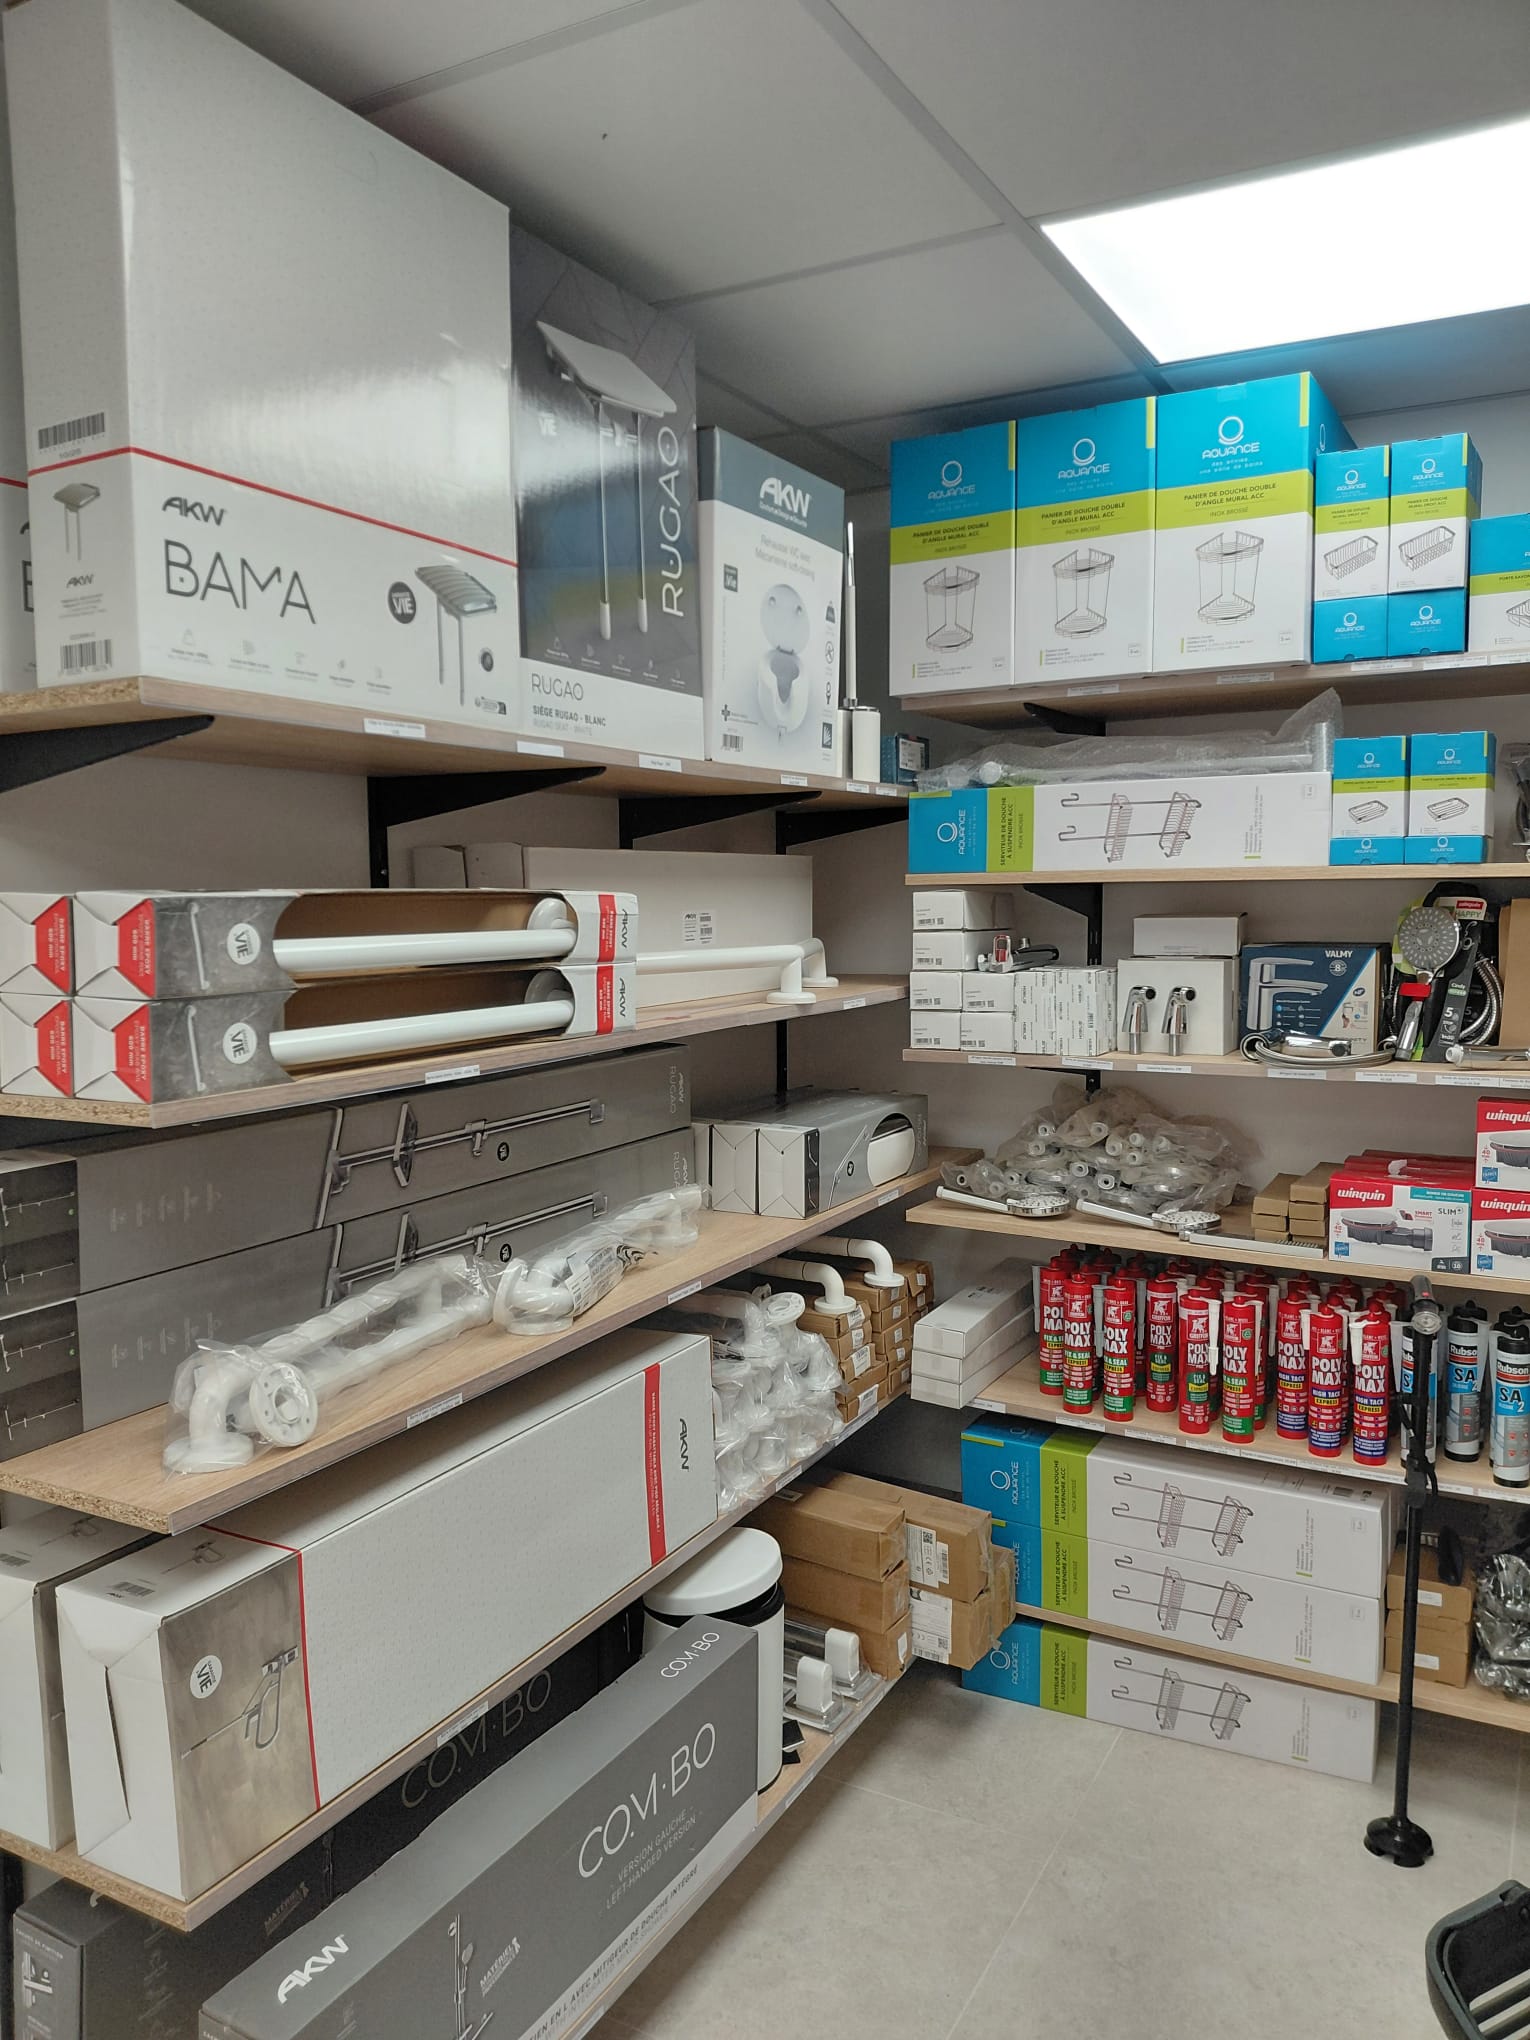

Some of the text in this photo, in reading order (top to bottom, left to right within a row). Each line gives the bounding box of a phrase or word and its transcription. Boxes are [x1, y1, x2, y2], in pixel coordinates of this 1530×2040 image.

[1202, 442, 1260, 459] AQUANCE
[1058, 463, 1111, 479] AQUANCE
[1412, 472, 1444, 481] AQUANCE
[927, 484, 976, 500] AQUANCE
[1184, 483, 1277, 501] PANIER DE DOUCHE DOUBLE
[1336, 482, 1367, 492] AQUANCE
[760, 477, 810, 518] AKW
[1195, 492, 1265, 508] D'ANGLE MURAL ACC
[162, 497, 224, 526] AKW
[1041, 502, 1126, 520] PANIER DE DOUCHE DOUBLE
[1051, 510, 1115, 526] D'ANGLE MURAL ACC
[1210, 509, 1225, 518] INOX
[658, 426, 684, 617] RUGAO
[913, 521, 989, 538] PANIER DE DOUCHE DOUBLE
[968, 530, 980, 538] ACC
[66, 574, 94, 588] AKW
[164, 539, 316, 624] BAMA
[1334, 625, 1365, 633] AQUANCE
[1410, 619, 1441, 628] AQUANCE
[531, 673, 584, 701] RUGAO
[555, 710, 579, 722] RUGAO
[585, 714, 606, 727] BLANC
[958, 809, 966, 855] AQUANCE
[1000, 824, 1007, 833] DE
[235, 931, 249, 958] VIE
[1325, 950, 1353, 958] VALMY
[1444, 1007, 1453, 1018] 5
[231, 1030, 245, 1058] VIE
[1065, 1320, 1091, 1335] POLY
[1150, 1324, 1172, 1335] POLY
[1064, 1333, 1091, 1347] MAX
[1150, 1335, 1172, 1345] MAX
[1278, 1341, 1304, 1357] POLY
[1450, 1344, 1477, 1356] Rubso
[1112, 1358, 1128, 1366] SEAL
[1278, 1355, 1306, 1370] MAX
[1312, 1356, 1341, 1372] POLY
[1497, 1361, 1529, 1375] Rubson
[1312, 1370, 1341, 1385] MAX
[1355, 1364, 1386, 1379] POLY
[1231, 1378, 1246, 1386] SEAL
[1280, 1381, 1302, 1389] EXPRESS
[1355, 1378, 1385, 1393] MAX
[1312, 1388, 1340, 1398] HIGH TACK
[1356, 1395, 1384, 1405] HIGH TACK
[1500, 1387, 1521, 1403] SA
[1358, 1404, 1381, 1412] EXPRESS
[680, 1418, 689, 1470] AKW
[1011, 1461, 1019, 1505] AQUANCE
[1054, 1485, 1060, 1493] DE
[1055, 1567, 1061, 1575] DE
[1011, 1642, 1019, 1685] AQUANCE
[1054, 1667, 1060, 1675] DE
[197, 1664, 212, 1693] VIE
[618, 1814, 686, 1882] VERSION GAUCHE
[606, 1815, 696, 1910] LEFT-HANDED VERSION
[550, 2007, 562, 2025] EN
[570, 1976, 592, 2003] AVEC
[593, 1938, 629, 1981] MITIGEUR
[630, 1926, 640, 1942] DE
[640, 1897, 670, 1931] DOUCHE
[277, 1935, 349, 2004] AKW
